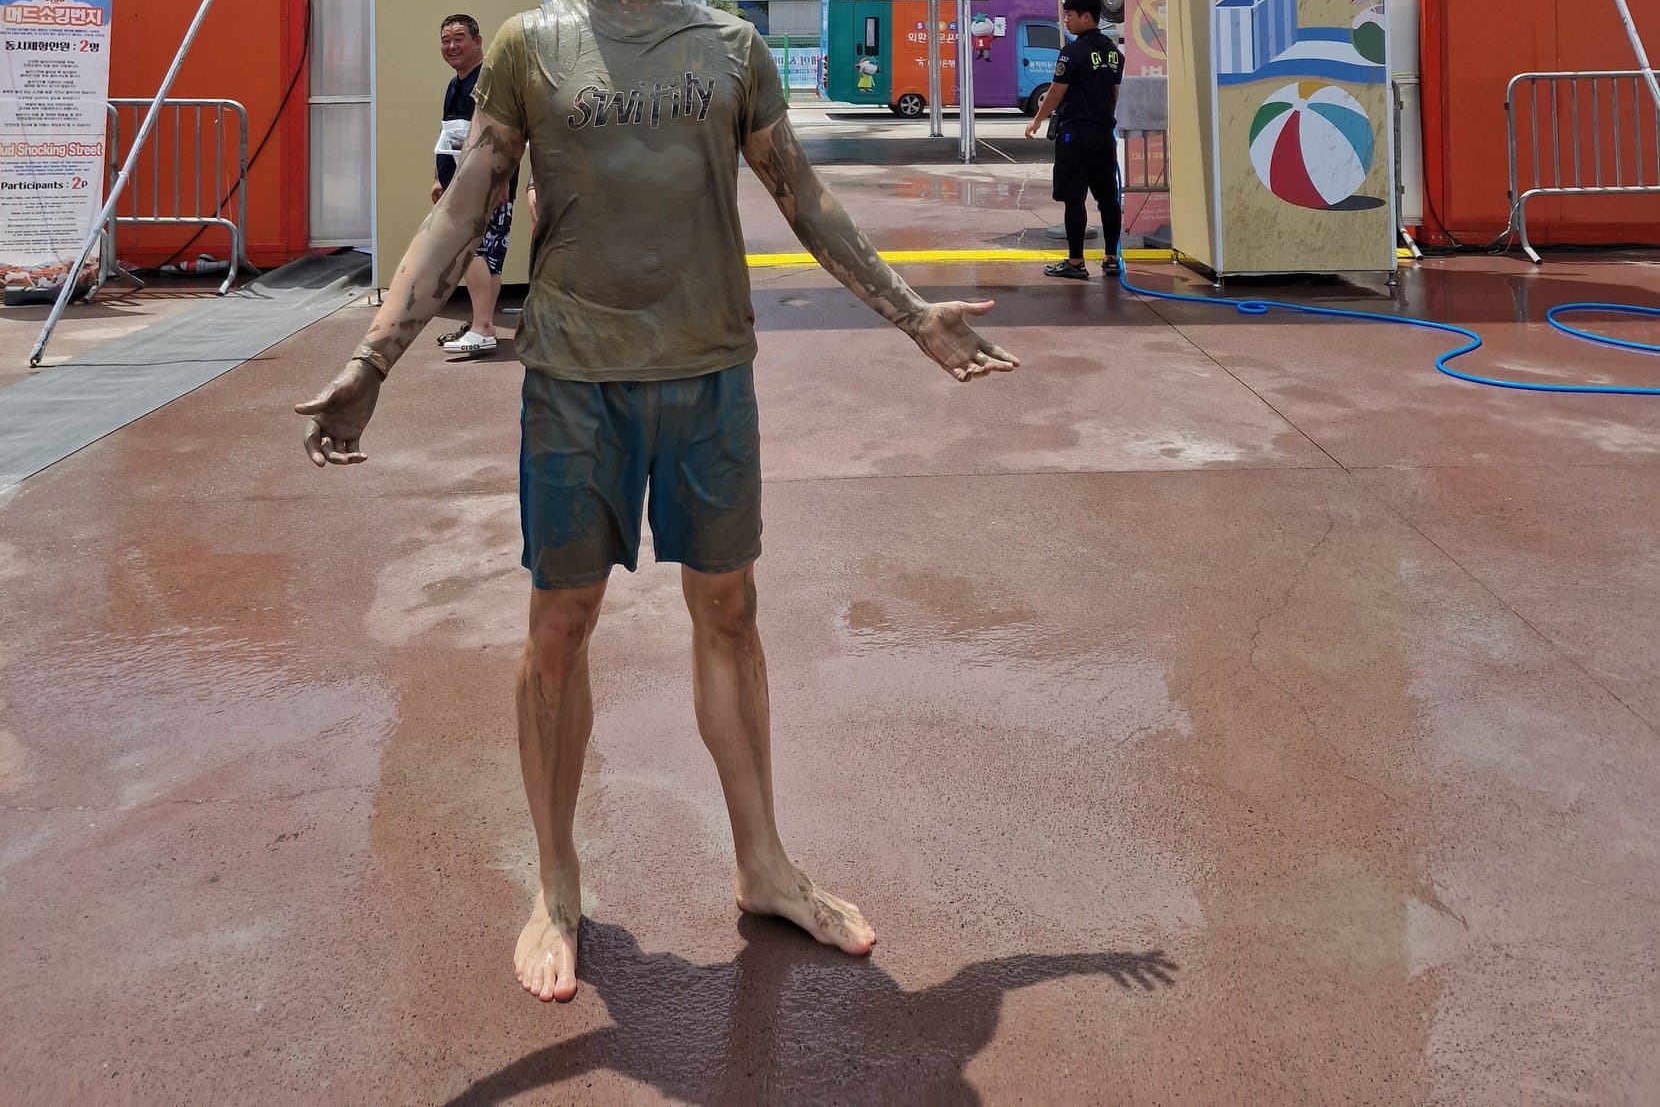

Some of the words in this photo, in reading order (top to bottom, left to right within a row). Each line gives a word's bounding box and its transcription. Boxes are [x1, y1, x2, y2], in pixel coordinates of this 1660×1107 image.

[0, 142, 16, 156] ud
[17, 141, 67, 157] Shocking
[68, 141, 102, 156] Street
[1, 181, 63, 190] Participants
